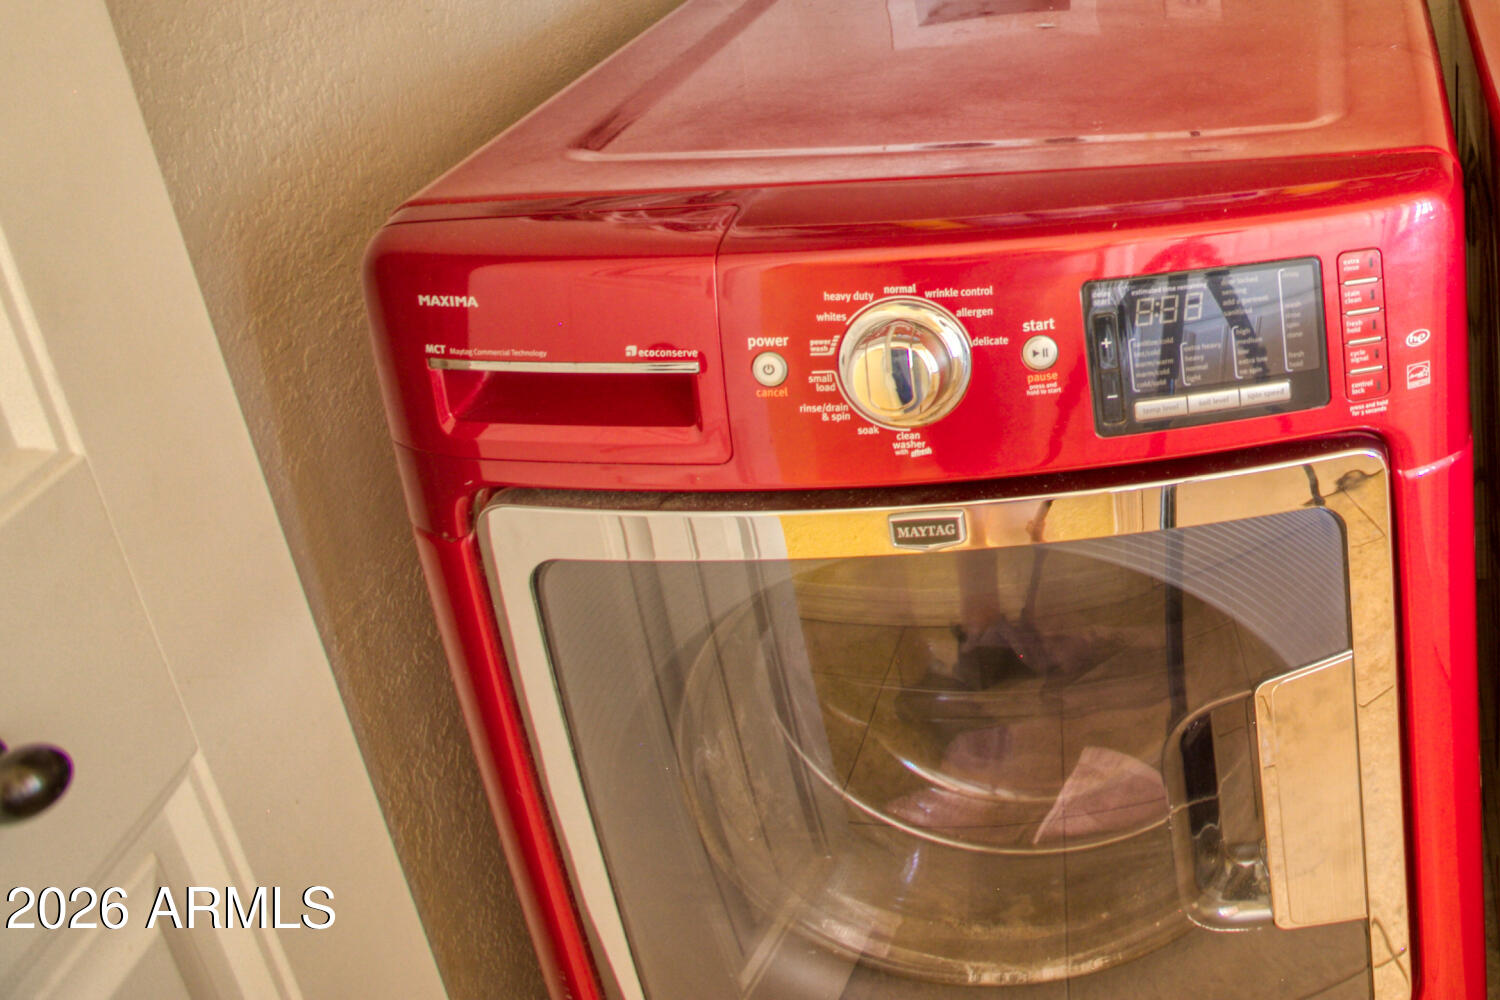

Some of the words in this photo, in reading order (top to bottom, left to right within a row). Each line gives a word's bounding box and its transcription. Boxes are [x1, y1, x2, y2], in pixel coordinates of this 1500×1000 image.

[1343, 258, 1360, 266] extra
[883, 284, 917, 294] normal
[925, 287, 960, 299] wrinkle
[961, 285, 993, 297] control
[1344, 290, 1360, 298] stain
[417, 294, 479, 308] MAXIMA
[824, 292, 852, 303] heavy
[853, 291, 874, 303] duty
[1344, 296, 1362, 304] clean
[816, 312, 847, 322] whites
[956, 307, 994, 319] allergen
[1022, 317, 1056, 332] start
[1346, 319, 1363, 327] fresh
[748, 335, 789, 350] power
[972, 335, 1009, 347] delicate
[425, 343, 446, 355] MCT
[449, 347, 473, 357] Maytag
[511, 348, 548, 359] Technology
[637, 348, 699, 358] ecoconserve
[1350, 349, 1366, 358] cycle
[1350, 355, 1369, 364] signal
[808, 374, 833, 384] small
[1027, 372, 1058, 384] pause
[815, 382, 836, 392] load
[1351, 379, 1374, 388] control
[756, 387, 788, 398] cancel
[1351, 386, 1365, 395] lock
[799, 403, 849, 414] rinse/drain
[1351, 409, 1360, 417] for
[1365, 406, 1387, 414] seconds
[822, 412, 829, 421] &
[831, 411, 851, 423] spin
[857, 424, 880, 435] soak
[896, 431, 921, 441] clean
[892, 440, 926, 449] washer
[897, 524, 955, 538] MAYTAG
